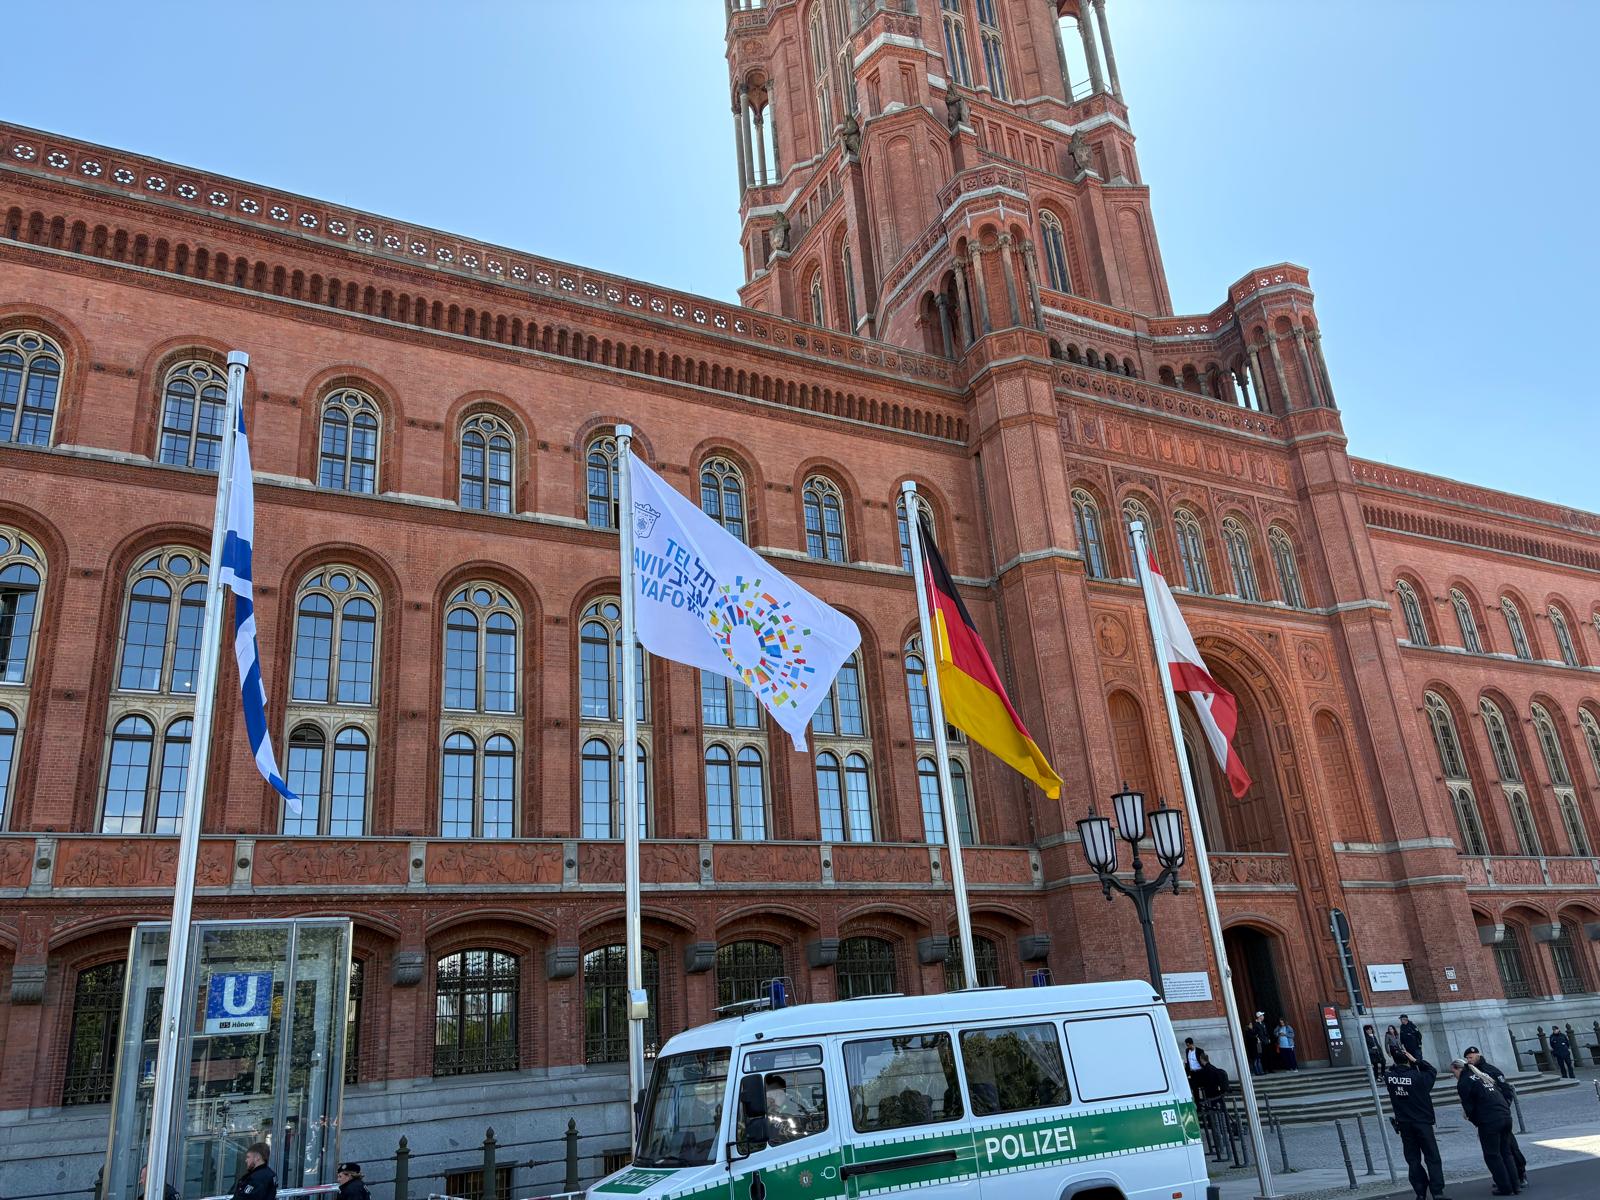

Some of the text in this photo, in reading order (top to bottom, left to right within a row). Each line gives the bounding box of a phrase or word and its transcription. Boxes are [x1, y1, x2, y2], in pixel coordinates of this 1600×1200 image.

[635, 547, 672, 580] AVIV
[665, 537, 691, 575] TEL
[641, 574, 685, 608] YAFO
[694, 557, 716, 595] תל
[222, 976, 258, 1015] U
[1388, 1076, 1412, 1086] POLIZEI
[1162, 1110, 1176, 1124] 34
[985, 1126, 1077, 1163] POLIZEI
